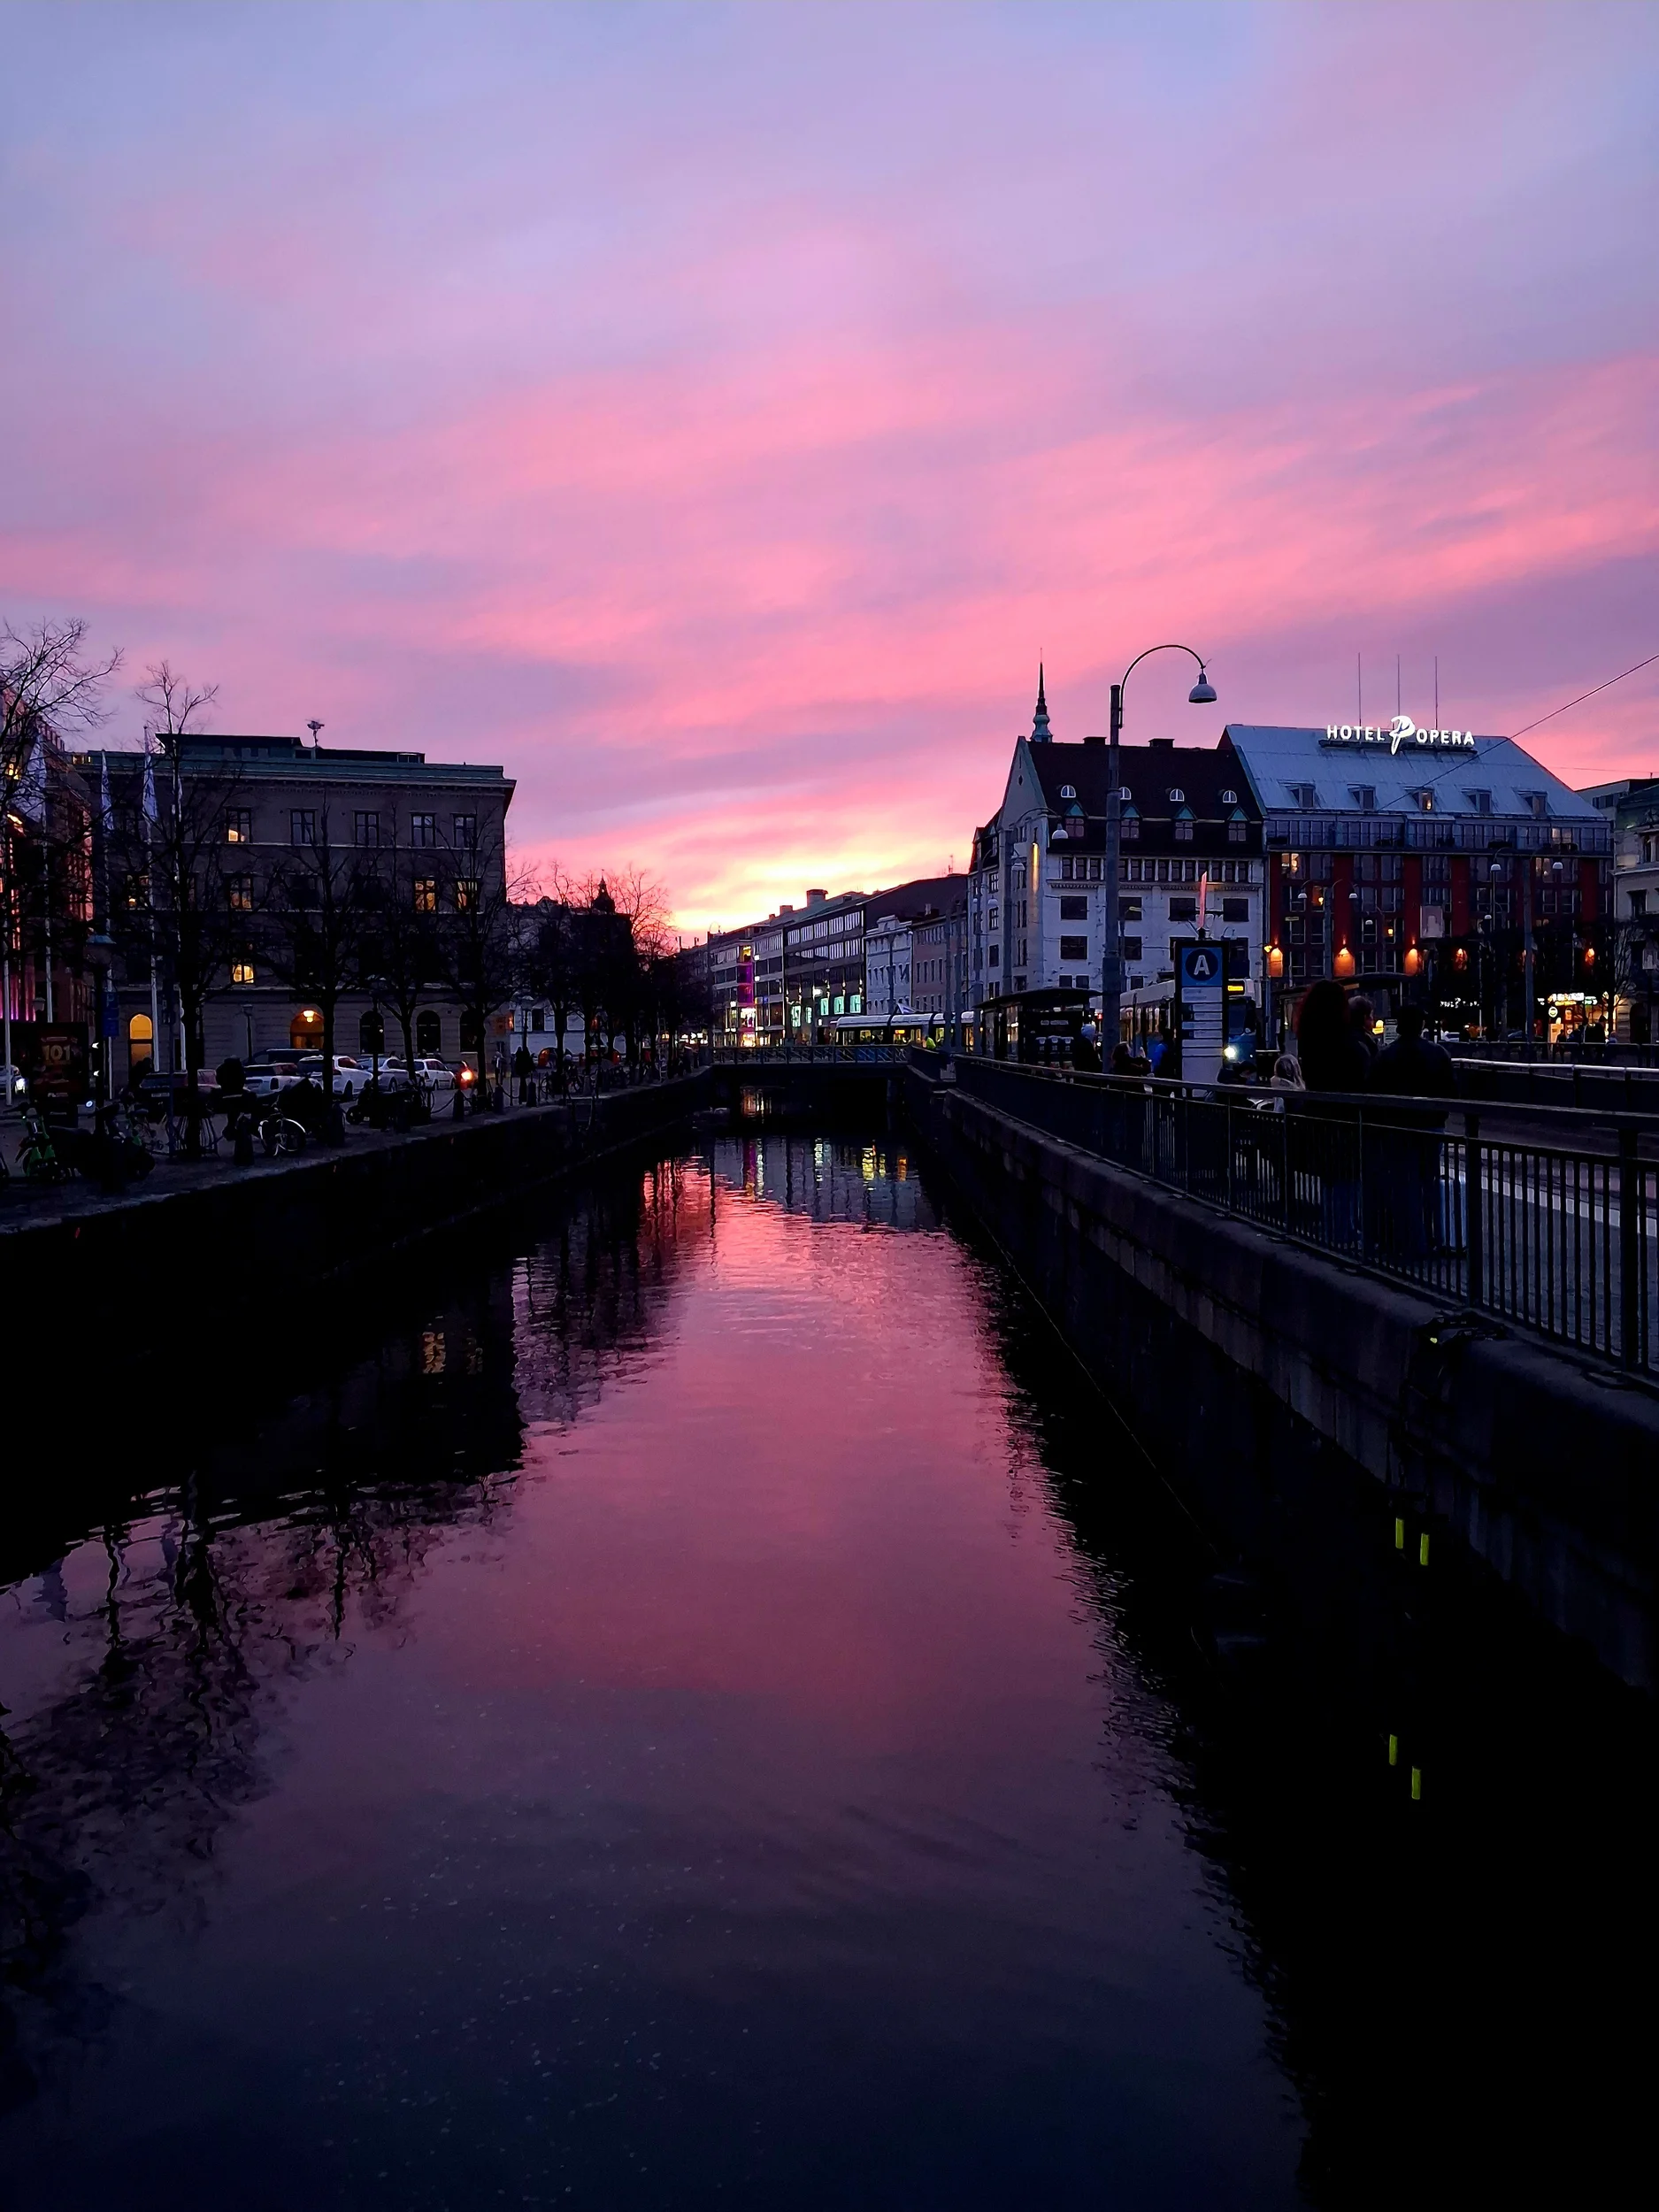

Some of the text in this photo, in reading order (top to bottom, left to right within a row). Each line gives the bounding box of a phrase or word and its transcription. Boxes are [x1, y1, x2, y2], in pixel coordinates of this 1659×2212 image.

[1326, 725, 1386, 741] HOTEL
[1416, 728, 1475, 746] OPERA
[1193, 954, 1210, 976] A
[41, 1044, 72, 1061] 101
